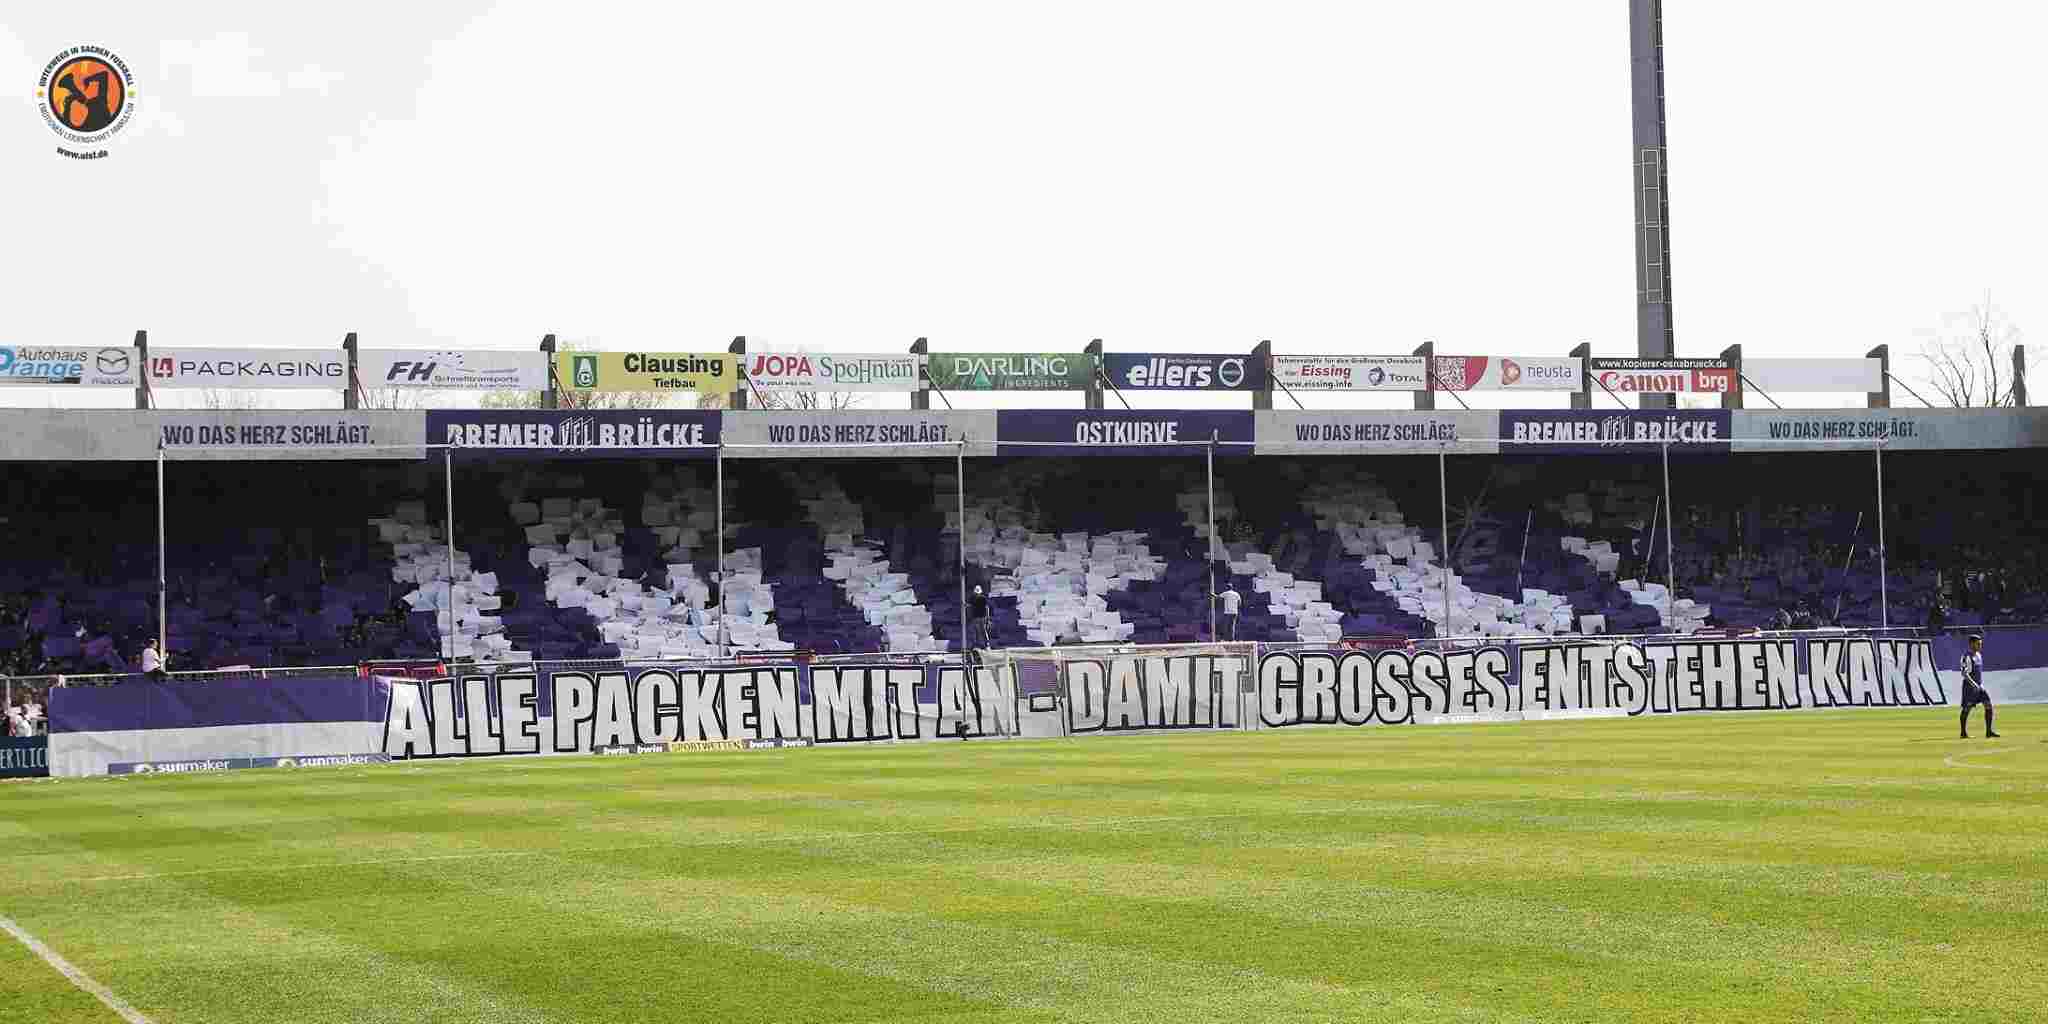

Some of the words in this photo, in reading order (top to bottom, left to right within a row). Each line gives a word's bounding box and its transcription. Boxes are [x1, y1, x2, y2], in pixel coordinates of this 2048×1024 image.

[17, 348, 88, 361] Autohaus
[624, 353, 723, 376] Clausing
[180, 361, 343, 376] PACKAGING
[386, 361, 437, 381] FH
[751, 355, 813, 376] JOPA
[954, 357, 1069, 376] DARLING
[1127, 358, 1212, 387] ellers
[1301, 365, 1351, 378] Eissing
[1527, 366, 1572, 378] neusta
[653, 378, 696, 388] Tiefbau
[1390, 374, 1423, 383] TOTAL
[1600, 371, 1684, 392] Canon
[1699, 371, 1728, 392] brg
[164, 426, 194, 444] WO
[199, 426, 236, 444] DAS
[241, 426, 286, 444] HERZ
[291, 422, 375, 444] SCHLÄGT.
[447, 424, 554, 448] BREMER
[600, 417, 704, 448] BRÜCKE
[769, 425, 795, 443] WO
[800, 425, 831, 443] DAS
[835, 425, 875, 443] HERZ
[879, 421, 953, 443] SCHLÄGT.
[1076, 422, 1178, 444] OSTKURVE
[1295, 424, 1318, 441] WO
[1323, 424, 1351, 441] DAS
[1355, 424, 1390, 441] HERZ
[1393, 421, 1459, 442] SCHLÄGT.
[1513, 422, 1598, 443] BREMER
[1634, 416, 1717, 443] BRÜCKE
[1769, 421, 1790, 439] WO
[1793, 421, 1820, 439] DAS
[1823, 421, 1856, 439] HERZ
[1858, 417, 1918, 439] SCHLÄGT.
[386, 675, 540, 759] ALLE
[552, 667, 802, 752] PACKEN
[809, 664, 926, 742] MIT
[937, 666, 1021, 740] AN
[1065, 655, 1248, 732] DAMIT
[1259, 645, 1512, 726] GROSSES
[1519, 638, 1800, 716] ENTSTEHEN
[1806, 637, 1947, 709] KANN
[637, 744, 662, 753] bwin
[750, 739, 775, 749] bwin
[157, 759, 230, 773] sunmaker
[299, 753, 369, 767] sunmaker
